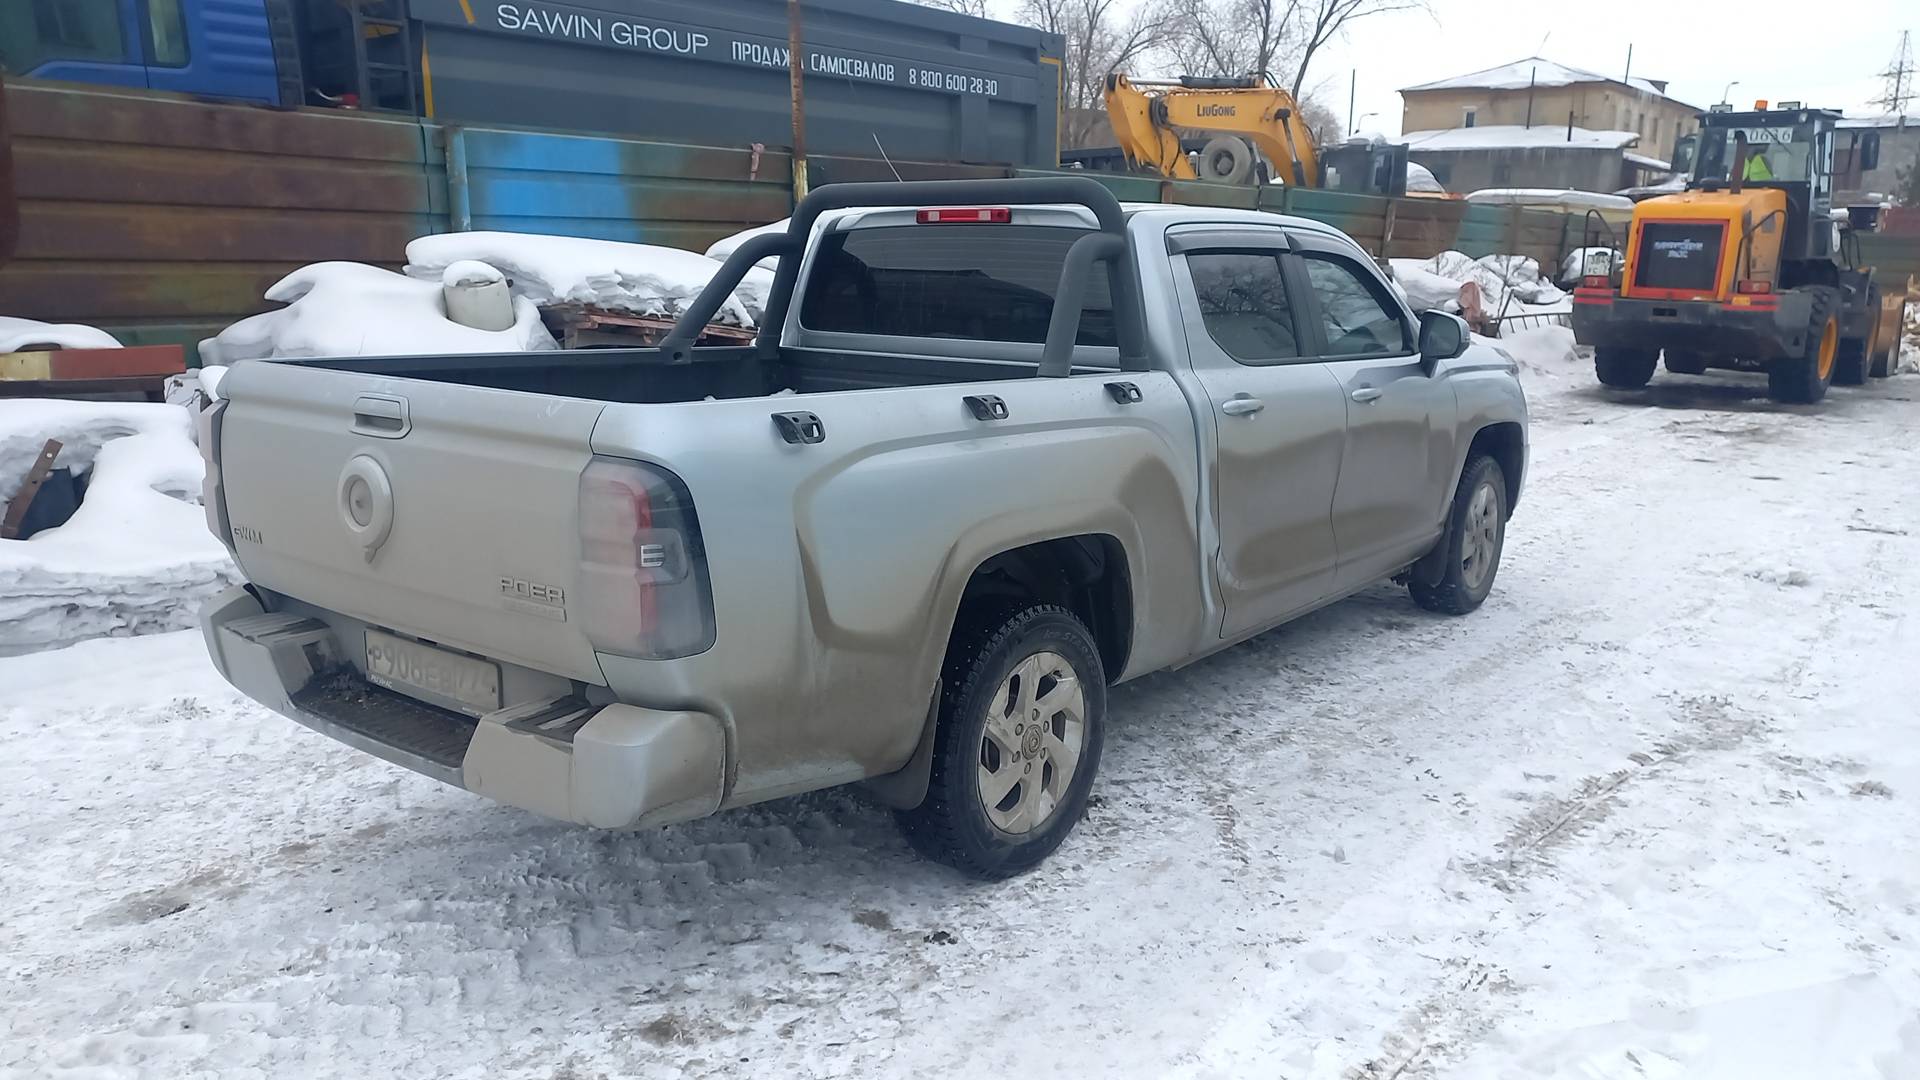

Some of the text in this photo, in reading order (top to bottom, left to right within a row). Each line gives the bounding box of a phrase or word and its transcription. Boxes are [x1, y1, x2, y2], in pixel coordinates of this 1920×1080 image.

[498, 4, 709, 54] SAWIN GROUP
[732, 41, 997, 96] ПРОДАЖ САМОСВАЛОВ 8 800 600 28 30
[501, 576, 565, 604] POER
